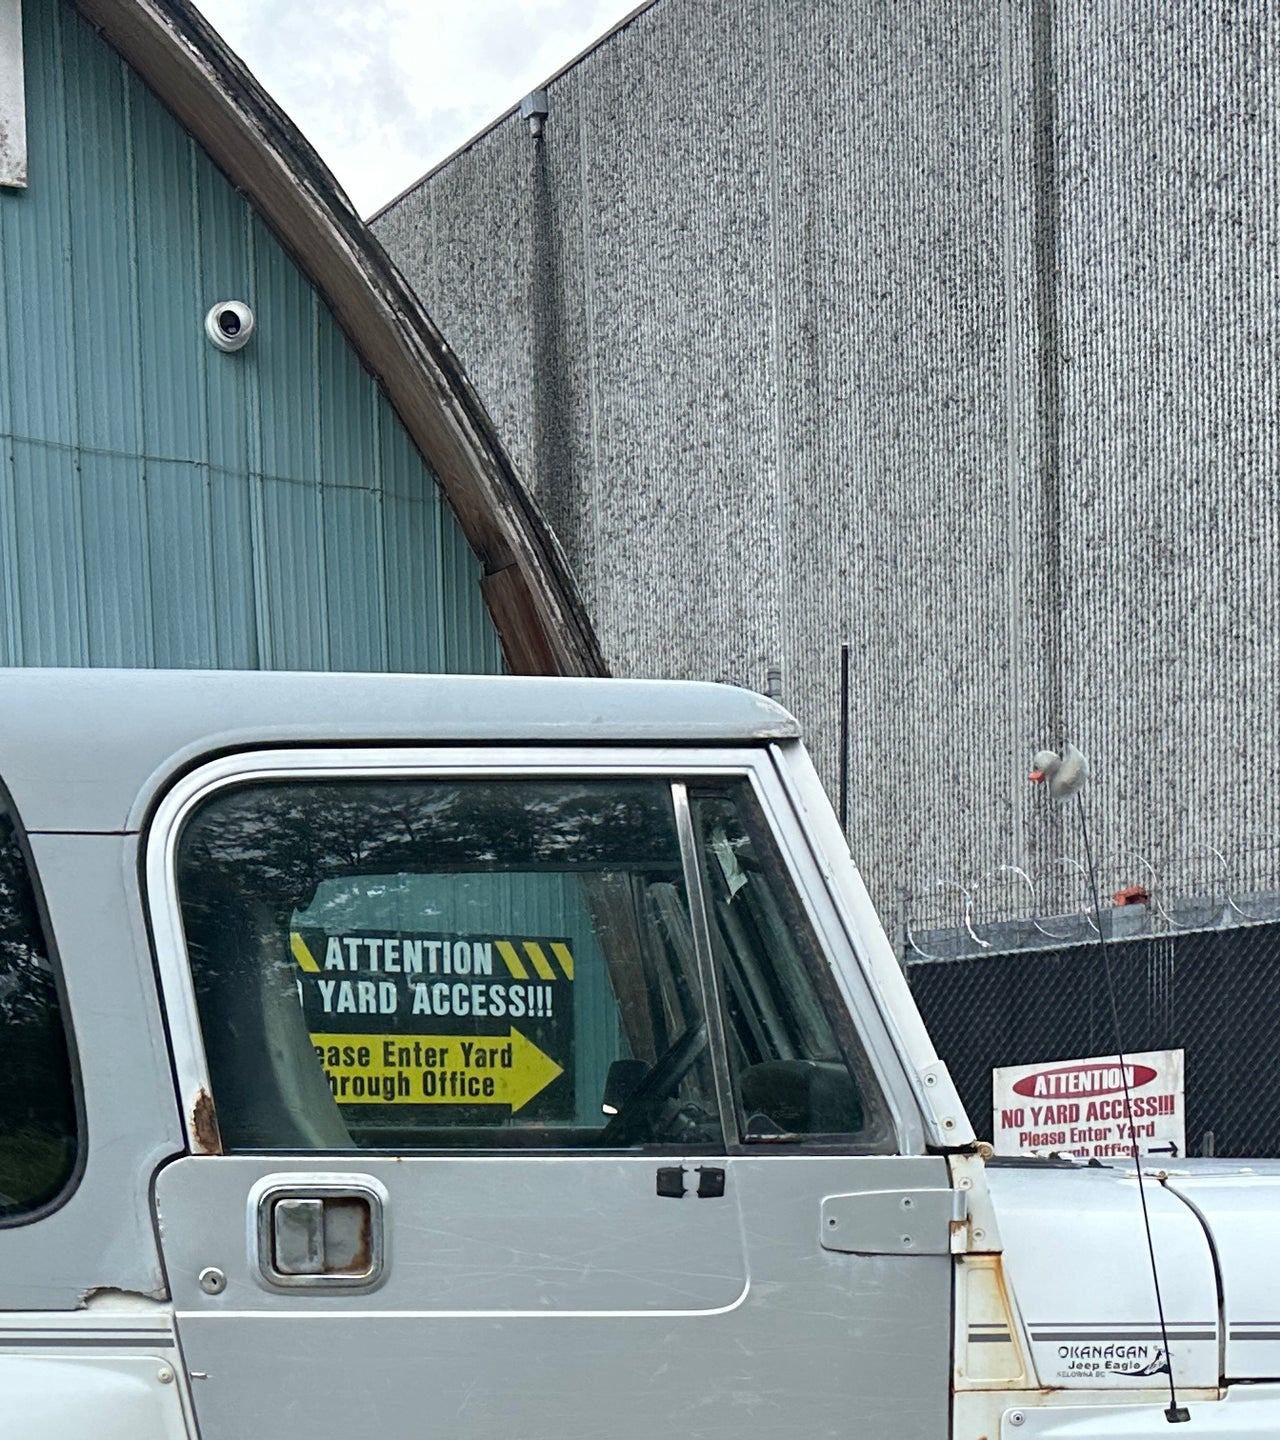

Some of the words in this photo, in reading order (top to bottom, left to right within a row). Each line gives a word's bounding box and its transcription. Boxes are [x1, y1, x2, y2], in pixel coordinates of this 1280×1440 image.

[324, 937, 492, 975] ATTENTION
[318, 979, 397, 1014] YARD
[412, 982, 554, 1017] ACCESS!!!
[314, 1044, 370, 1067] ease
[383, 1041, 448, 1067] Enter
[460, 1042, 513, 1069] Yard
[325, 1070, 410, 1101] hrough
[422, 1070, 494, 1097] Office
[1033, 1066, 1135, 1096] ATTENTION
[1001, 1107, 1025, 1129] NO
[1028, 1104, 1080, 1126] YARD
[1086, 1094, 1175, 1120] ACCESS!!!
[1019, 1128, 1066, 1148] Please
[1070, 1125, 1112, 1143] Enter
[1116, 1121, 1155, 1140] Yard
[1058, 1344, 1148, 1359] OKANAGAN
[1068, 1360, 1100, 1371] Jeep
[1105, 1360, 1141, 1371] Eagle
